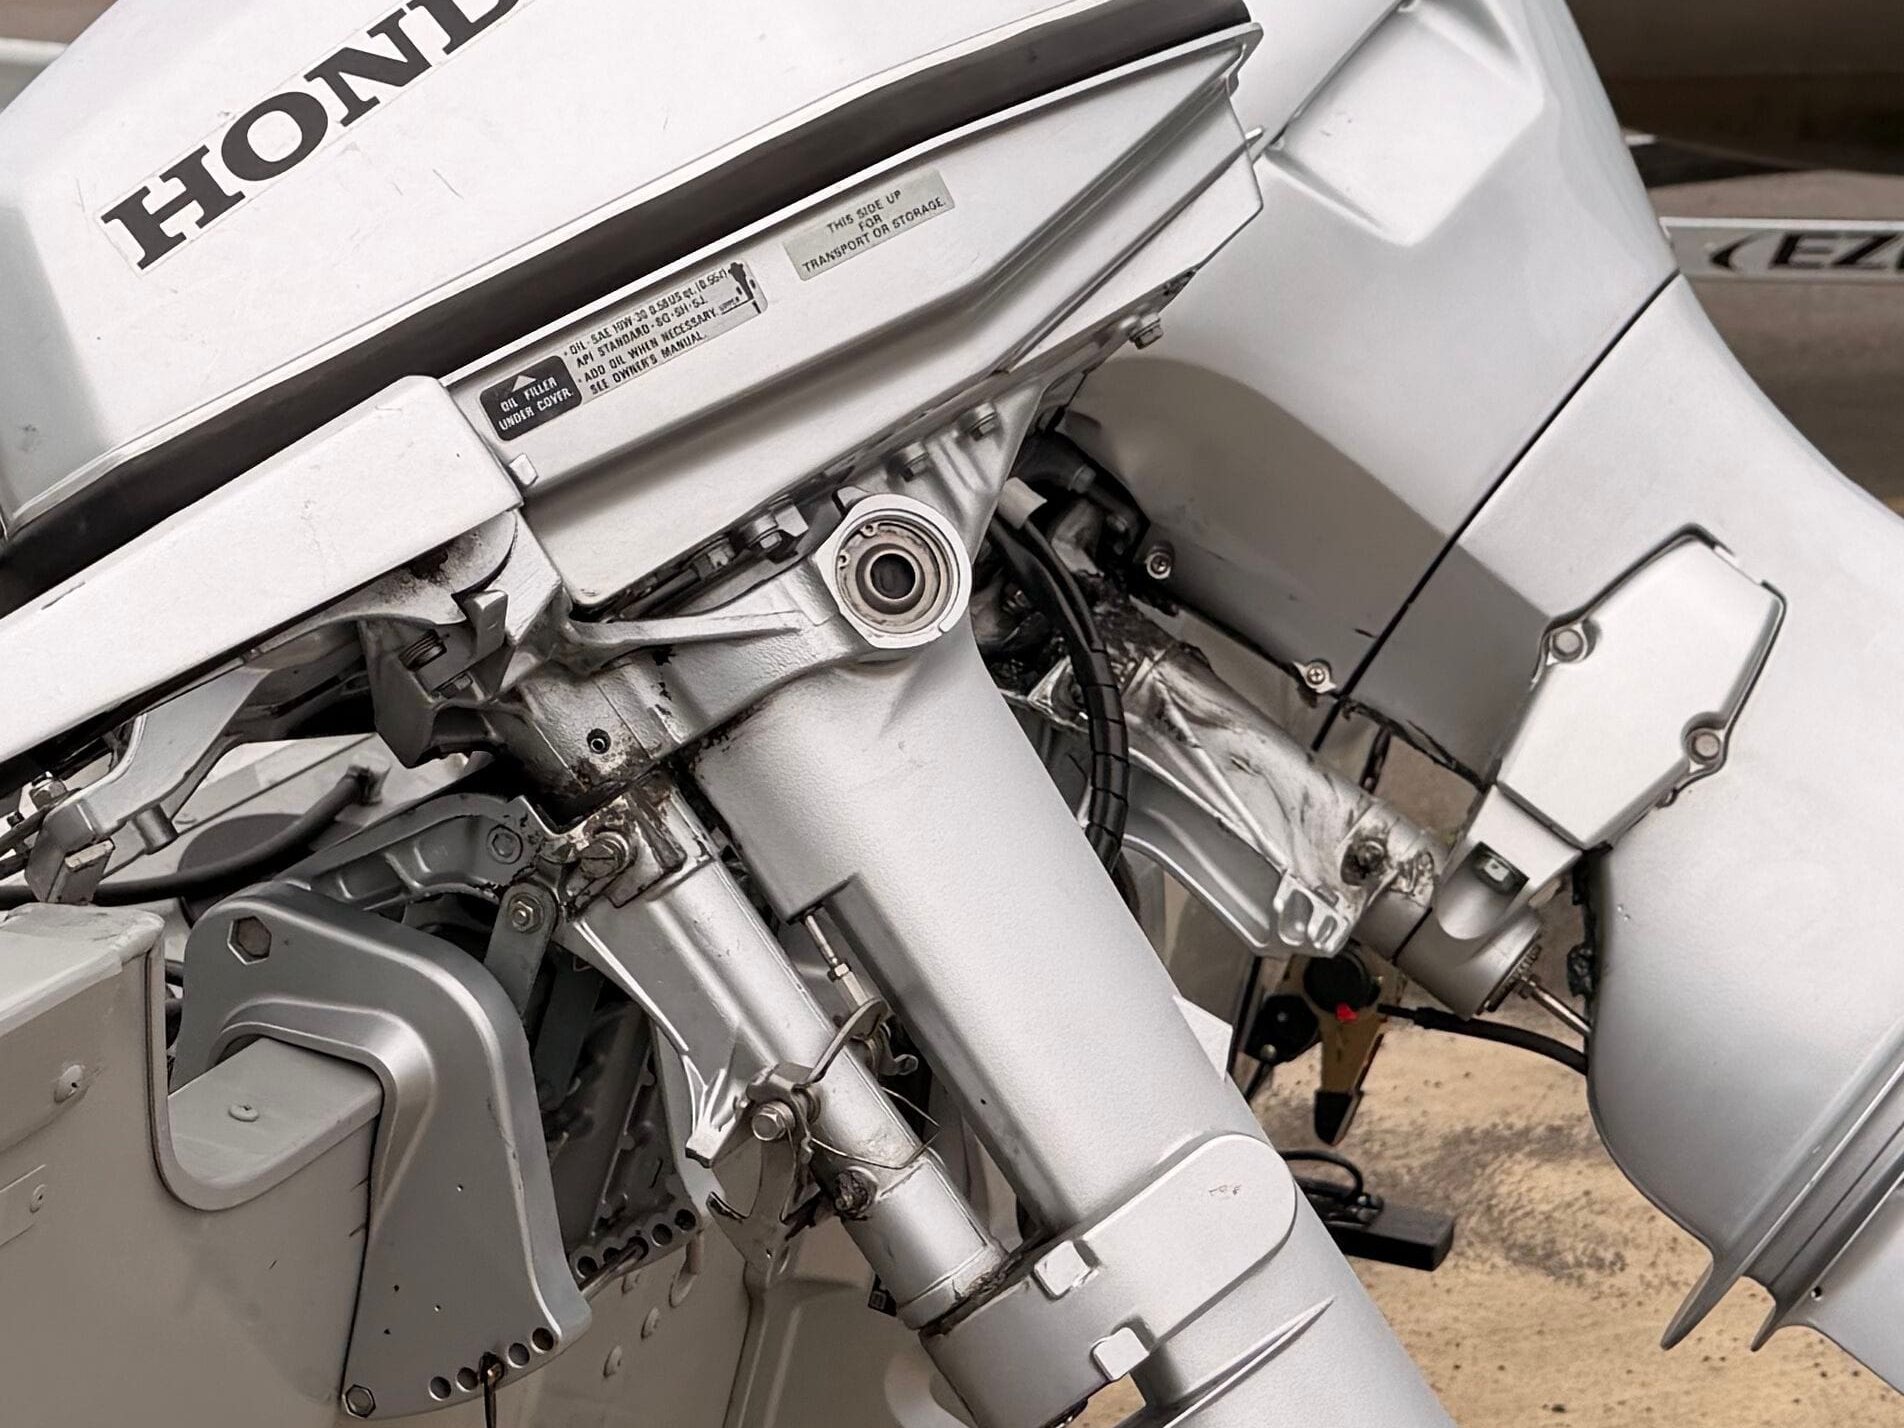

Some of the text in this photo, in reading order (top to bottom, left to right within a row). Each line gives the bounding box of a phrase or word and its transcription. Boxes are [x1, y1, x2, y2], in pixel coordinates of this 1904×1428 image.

[826, 190, 901, 233] THIS SIDE UP
[858, 214, 883, 232] FOR
[802, 232, 870, 272] TRANSPORT
[872, 224, 890, 238] OR
[569, 341, 587, 355] OIL
[591, 328, 612, 345] SAE
[576, 351, 594, 368] API
[597, 324, 650, 357] STANDARD
[584, 364, 606, 383] ADD
[609, 355, 626, 369] OIL
[627, 337, 659, 359] WHEN
[500, 377, 557, 412] OIL FILLER
[590, 378, 610, 395] SEE
[612, 354, 658, 383] OWNER'S
[498, 406, 535, 430] UNDER
